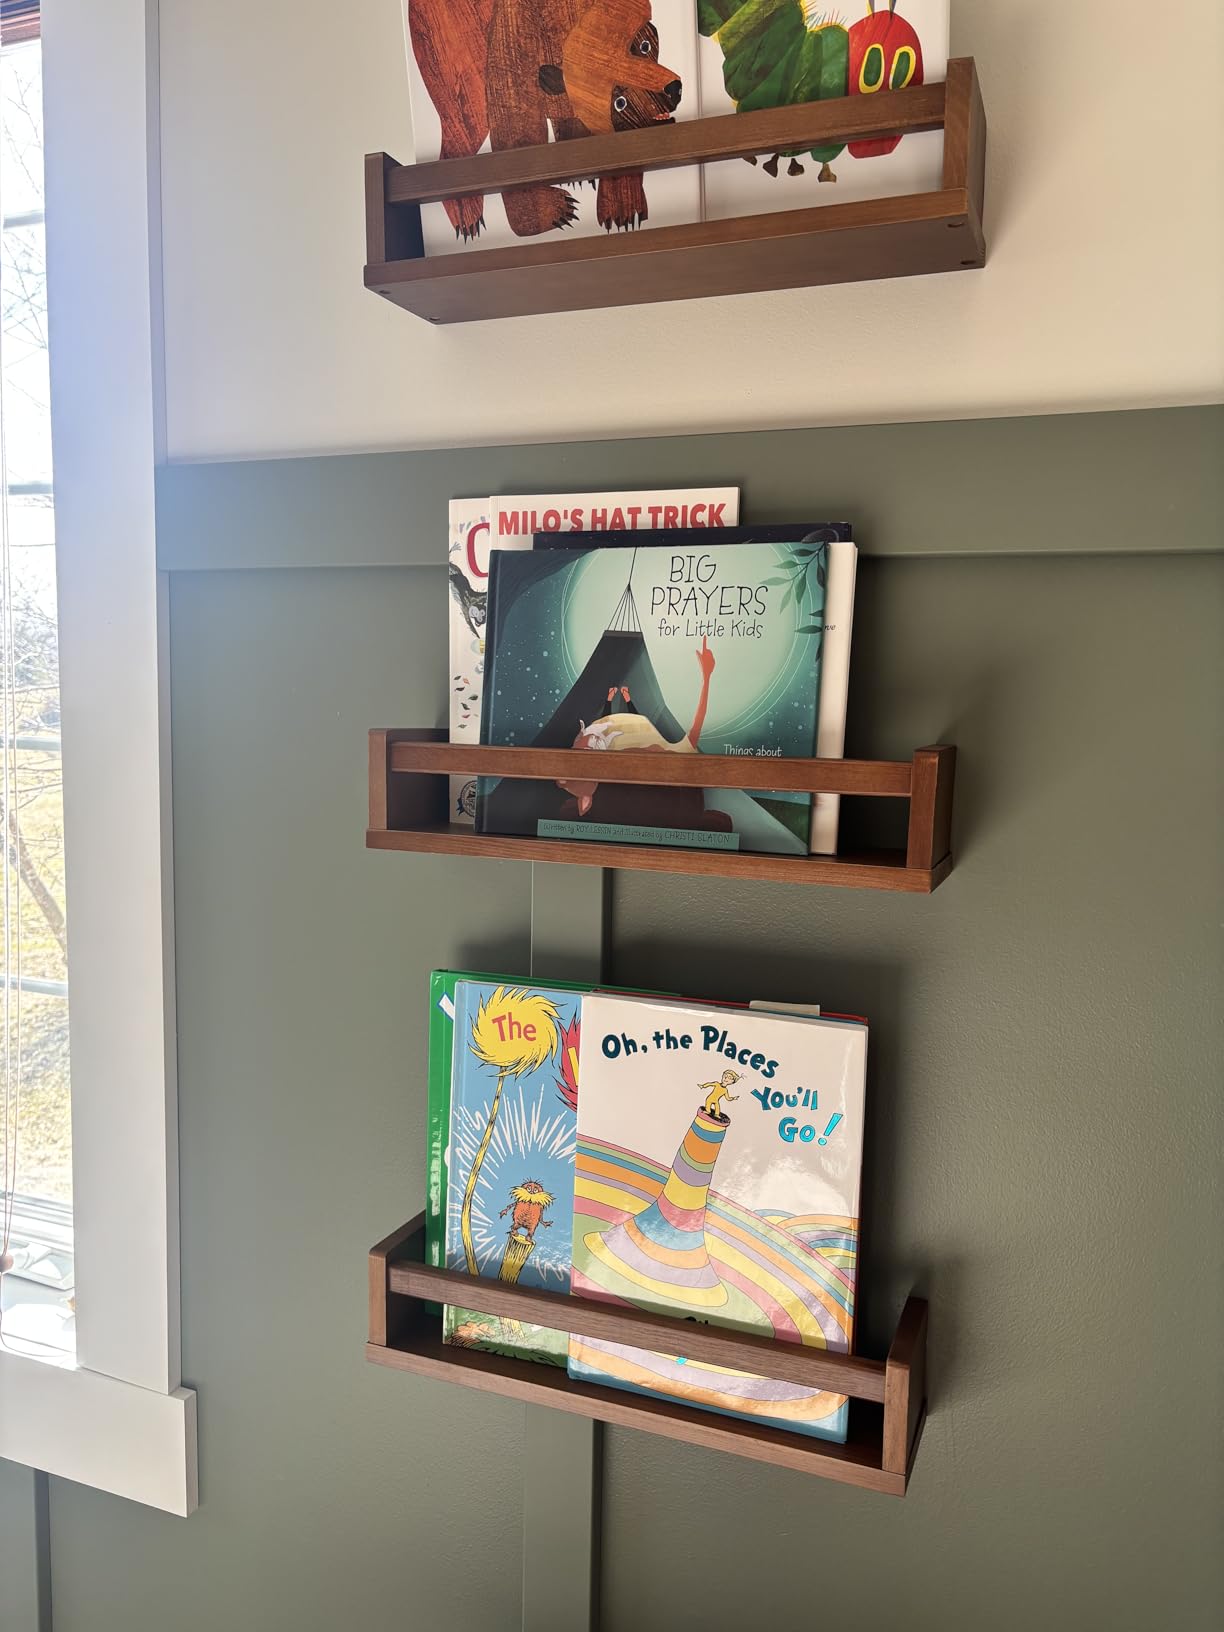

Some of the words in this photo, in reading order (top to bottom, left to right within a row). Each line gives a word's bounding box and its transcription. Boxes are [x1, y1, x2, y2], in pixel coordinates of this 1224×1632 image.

[498, 508, 584, 535] MILO'S
[591, 507, 642, 531] HAT
[648, 503, 727, 529] TRICK
[669, 554, 717, 583] BIG
[650, 585, 769, 616] PRAYERS
[657, 618, 680, 637] for
[685, 618, 725, 638] Little
[731, 619, 764, 639] Kids
[723, 743, 754, 756] Things
[755, 744, 783, 758] about
[664, 831, 695, 841] CHRISTI
[491, 1011, 537, 1042] The
[601, 1032, 648, 1059] Oh,
[652, 1028, 693, 1050] the
[700, 1025, 780, 1079] Places
[750, 1086, 818, 1111] You'll
[778, 1112, 843, 1146] Go!
